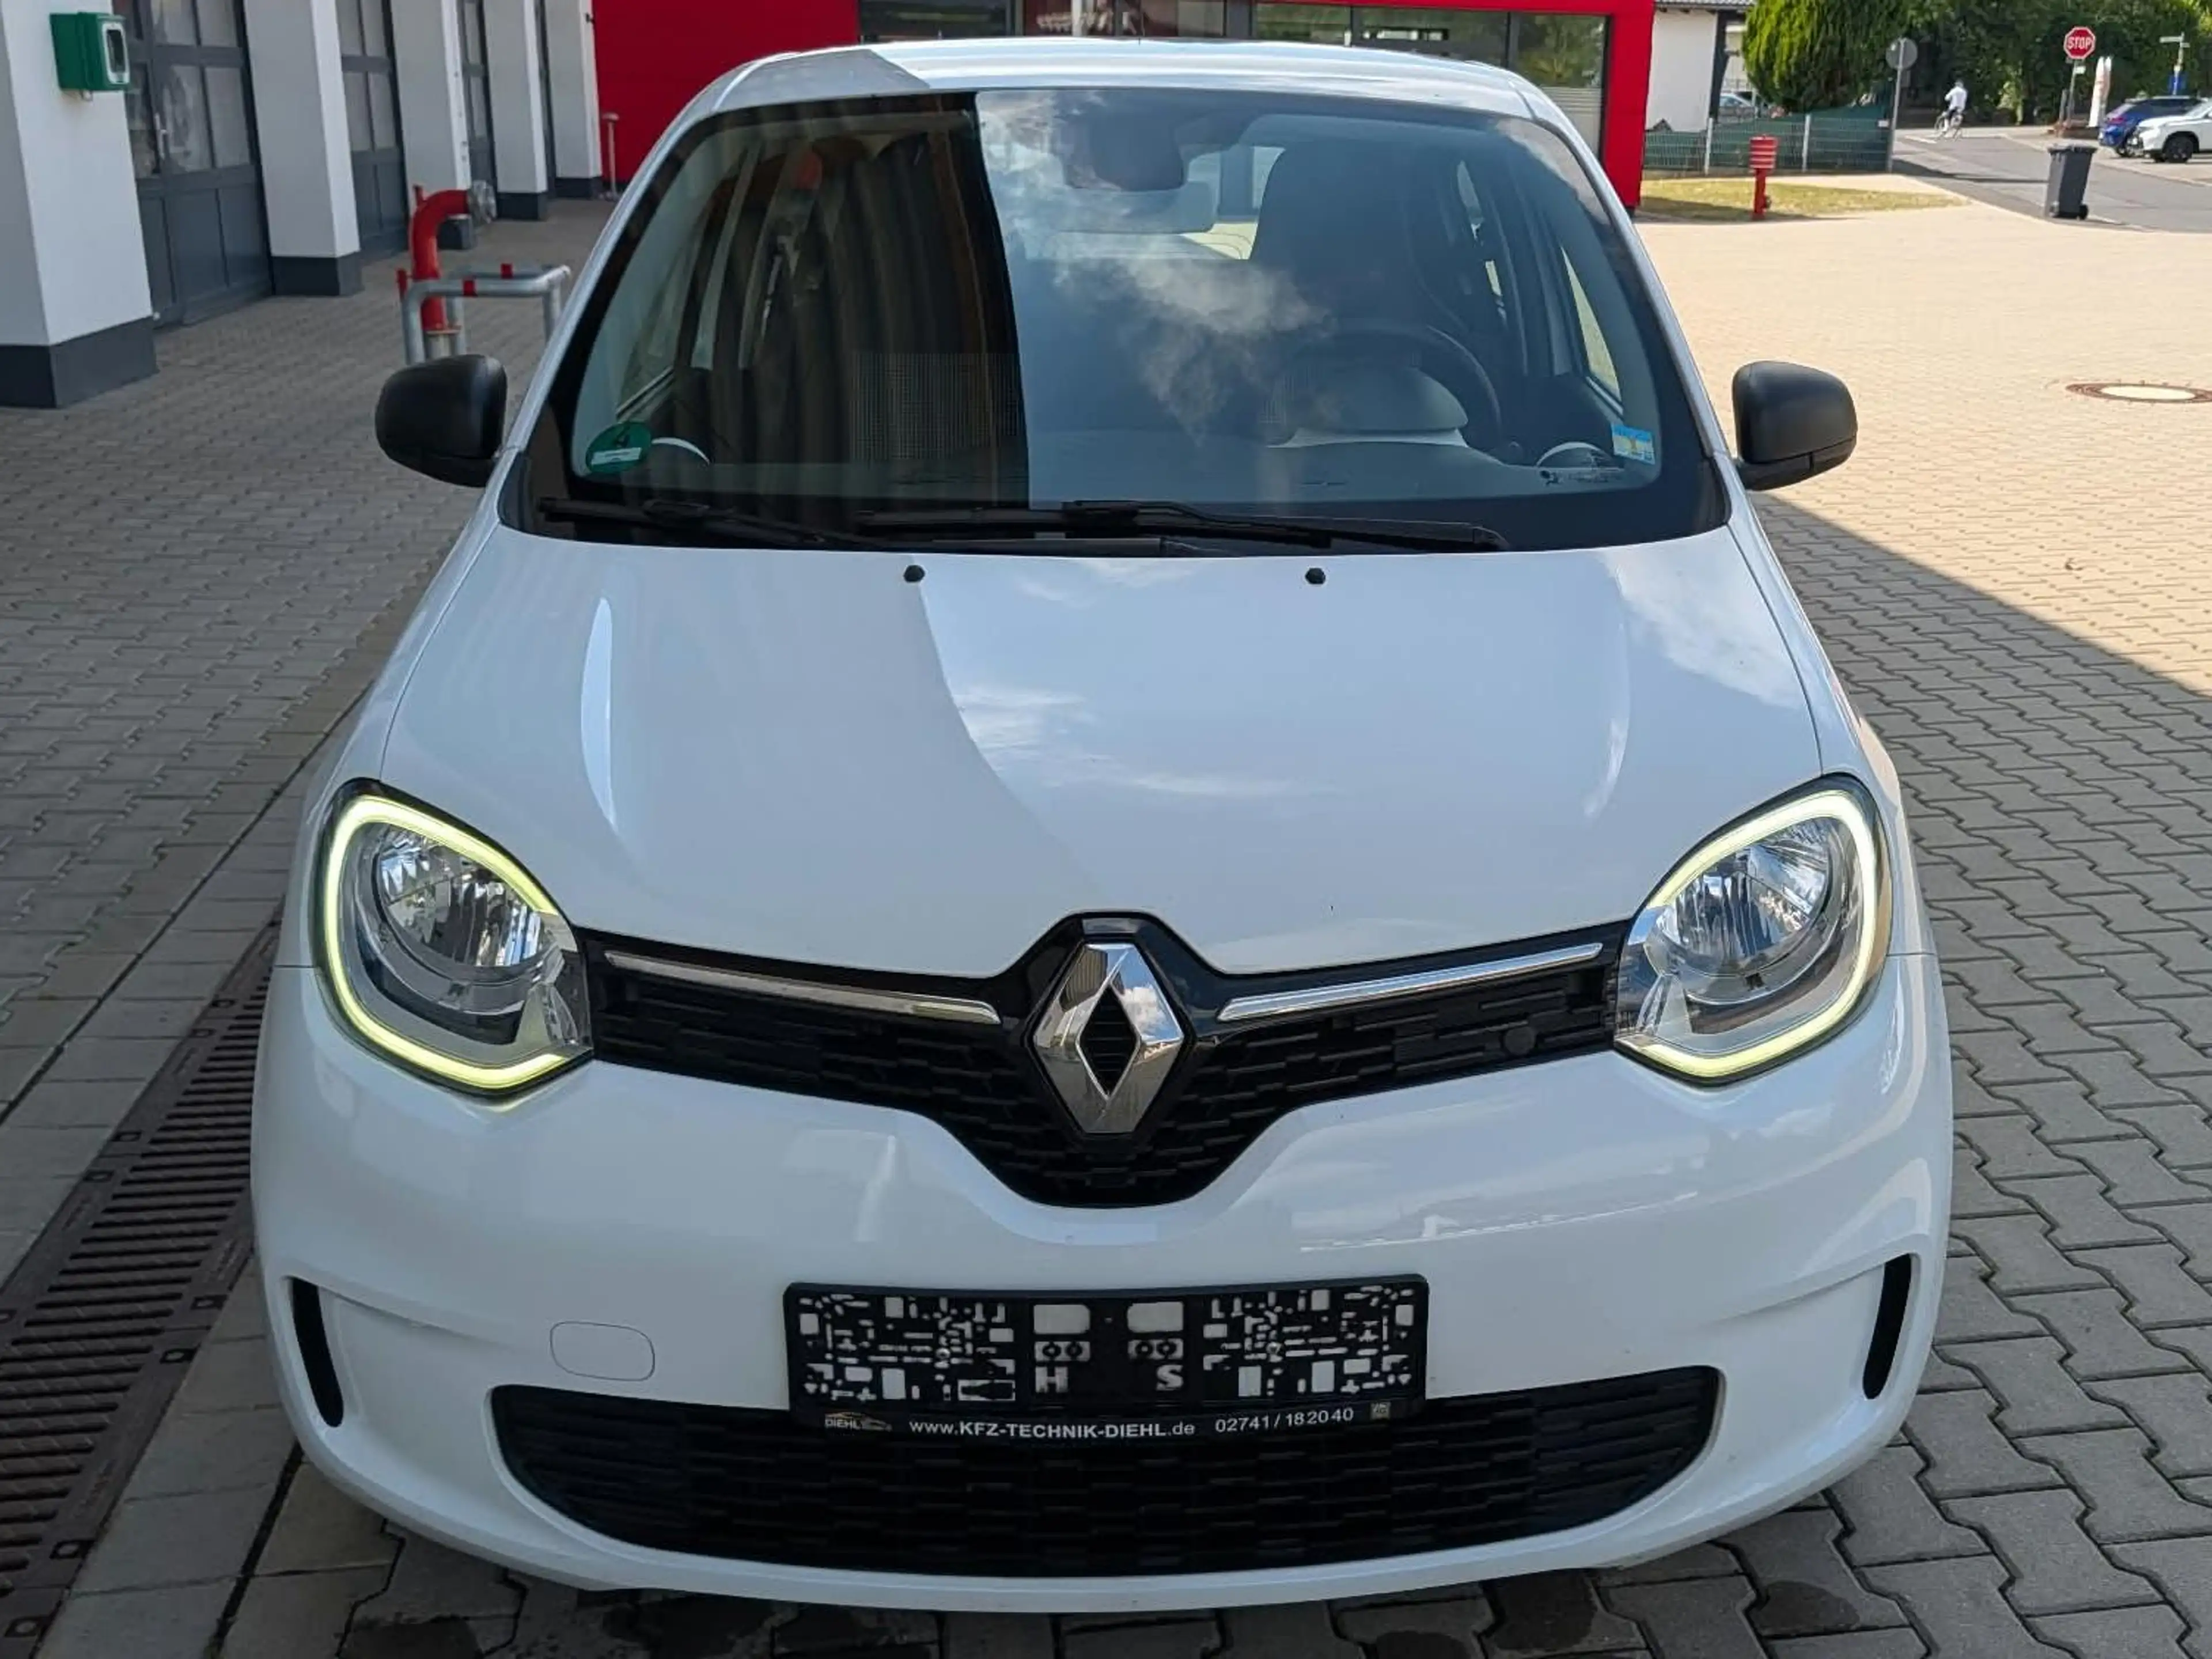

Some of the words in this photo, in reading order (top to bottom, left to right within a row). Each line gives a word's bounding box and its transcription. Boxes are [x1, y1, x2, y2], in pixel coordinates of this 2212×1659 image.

[2067, 36, 2092, 50] STOP
[824, 1418, 865, 1430] DIEHL
[908, 1421, 1195, 1438] www.KFZ-TECHNIK-DIEHL.de
